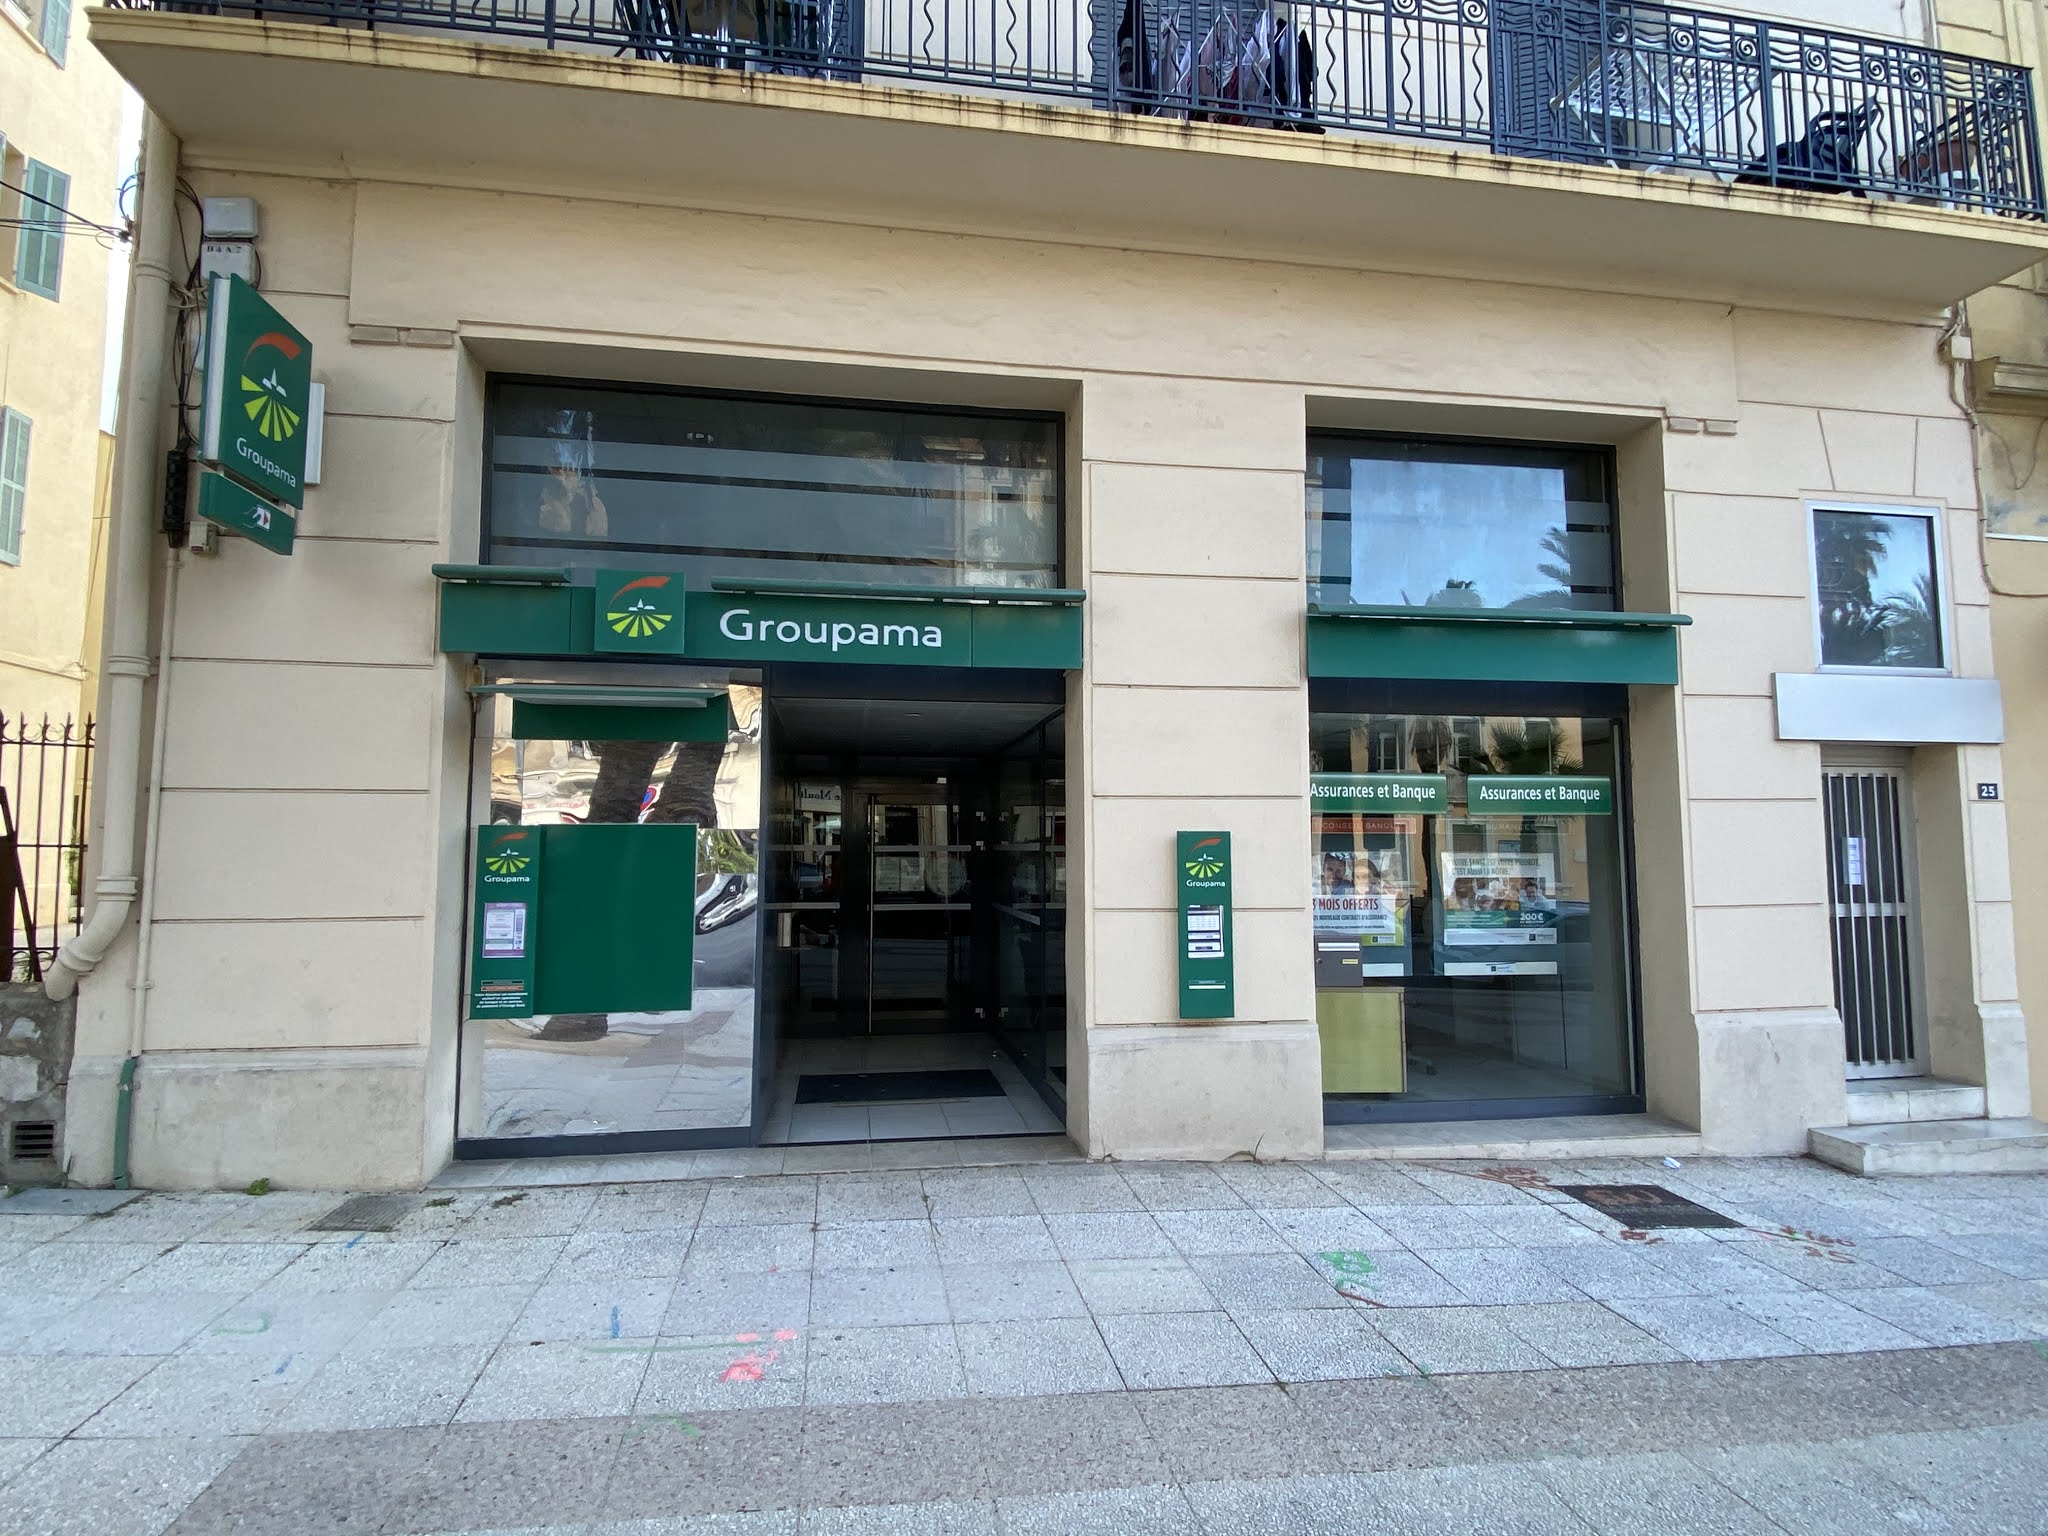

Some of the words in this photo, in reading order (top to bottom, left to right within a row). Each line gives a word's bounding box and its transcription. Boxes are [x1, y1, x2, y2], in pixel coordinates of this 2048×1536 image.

[236, 437, 296, 488] Groupama
[719, 608, 942, 652] Groupama
[1310, 783, 1374, 798] Assurances
[1377, 786, 1390, 798] et
[1392, 784, 1436, 802] Banque
[1480, 785, 1542, 800] Assurances
[1545, 787, 1557, 800] et
[1559, 786, 1601, 803] Banque
[1981, 785, 1995, 797] 25
[1322, 822, 1362, 830] CONSE
[1365, 822, 1402, 830] BANQU
[484, 875, 530, 883] Groupama
[1186, 879, 1226, 888] Groupama
[1319, 898, 1341, 910] MOIS
[1342, 898, 1379, 910] OFFERTS
